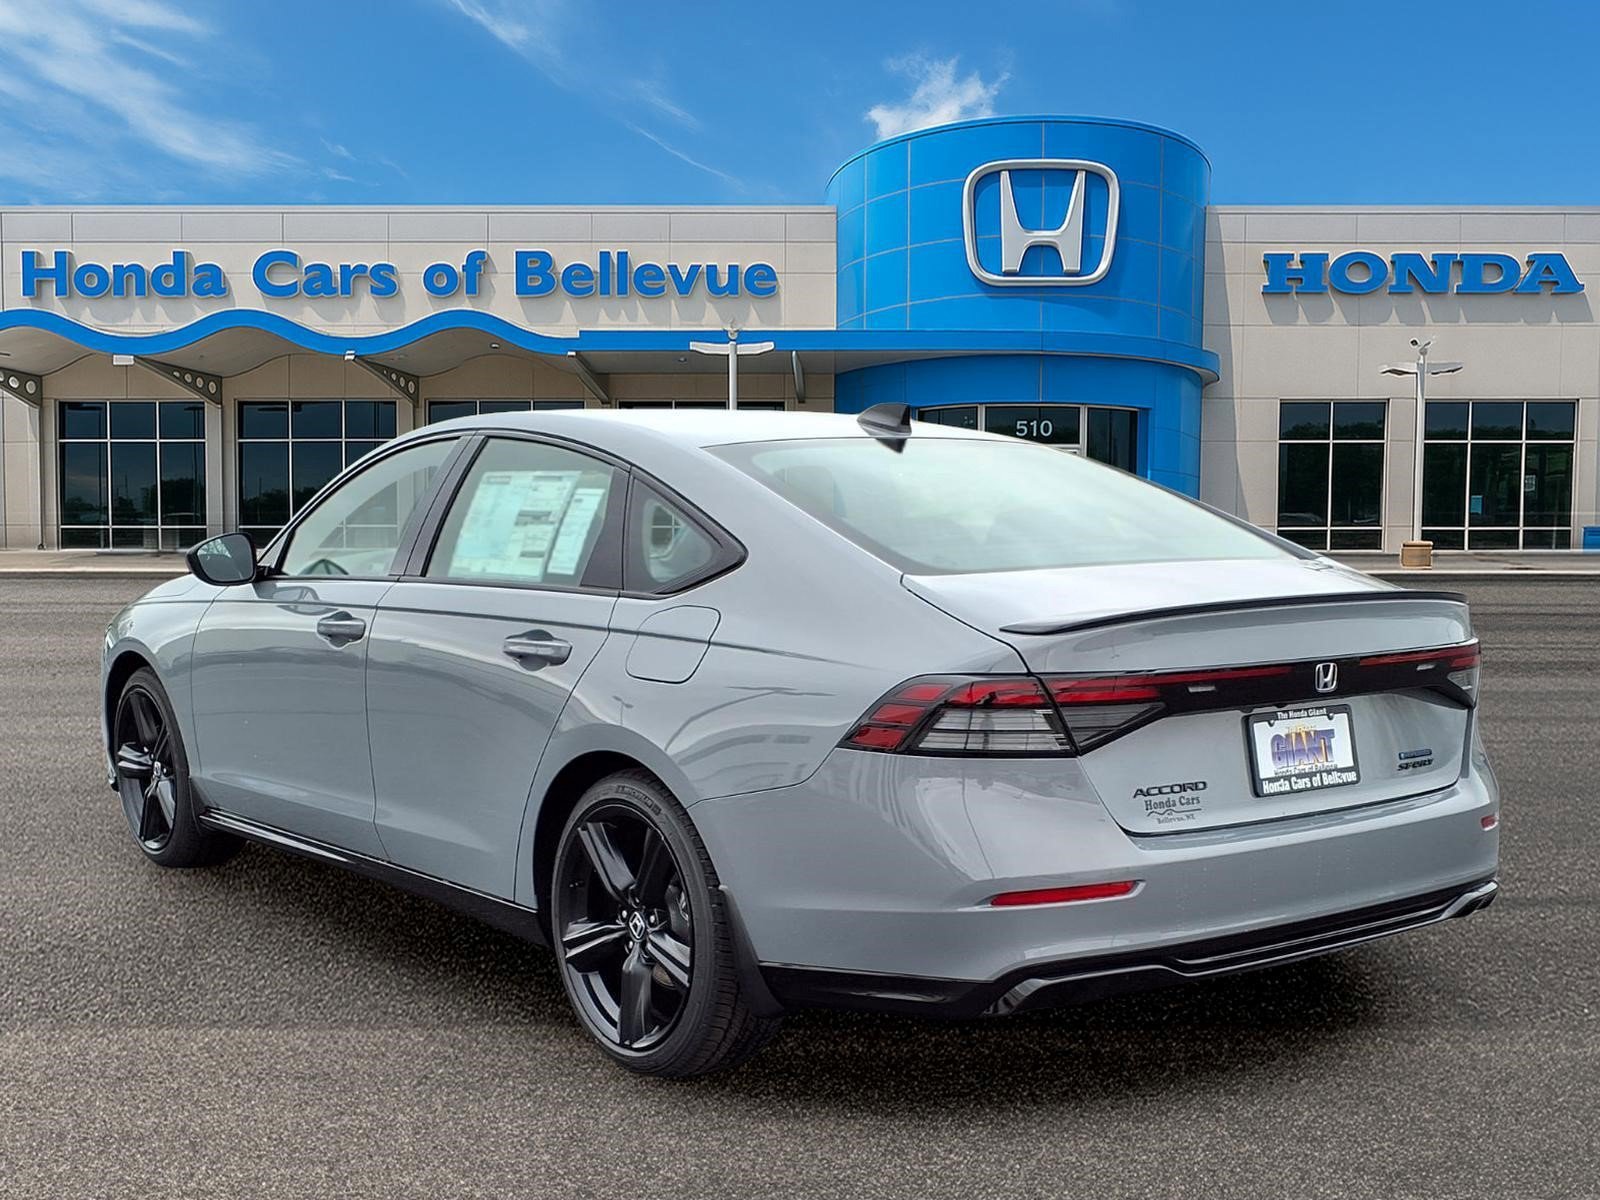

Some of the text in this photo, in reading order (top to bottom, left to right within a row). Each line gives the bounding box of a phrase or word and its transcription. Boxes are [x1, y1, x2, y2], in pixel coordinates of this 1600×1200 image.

[20, 249, 778, 298] Honda Cars of Bellevue
[1262, 251, 1585, 295] HONDA
[1015, 420, 1053, 437] 510
[1277, 707, 1327, 720] The Honda Giant
[1270, 728, 1335, 768] GIANT
[1132, 781, 1207, 798] ACCORD
[1262, 771, 1357, 794] Honda Cars of Bellevue
[1144, 795, 1201, 811] Honda Cars
